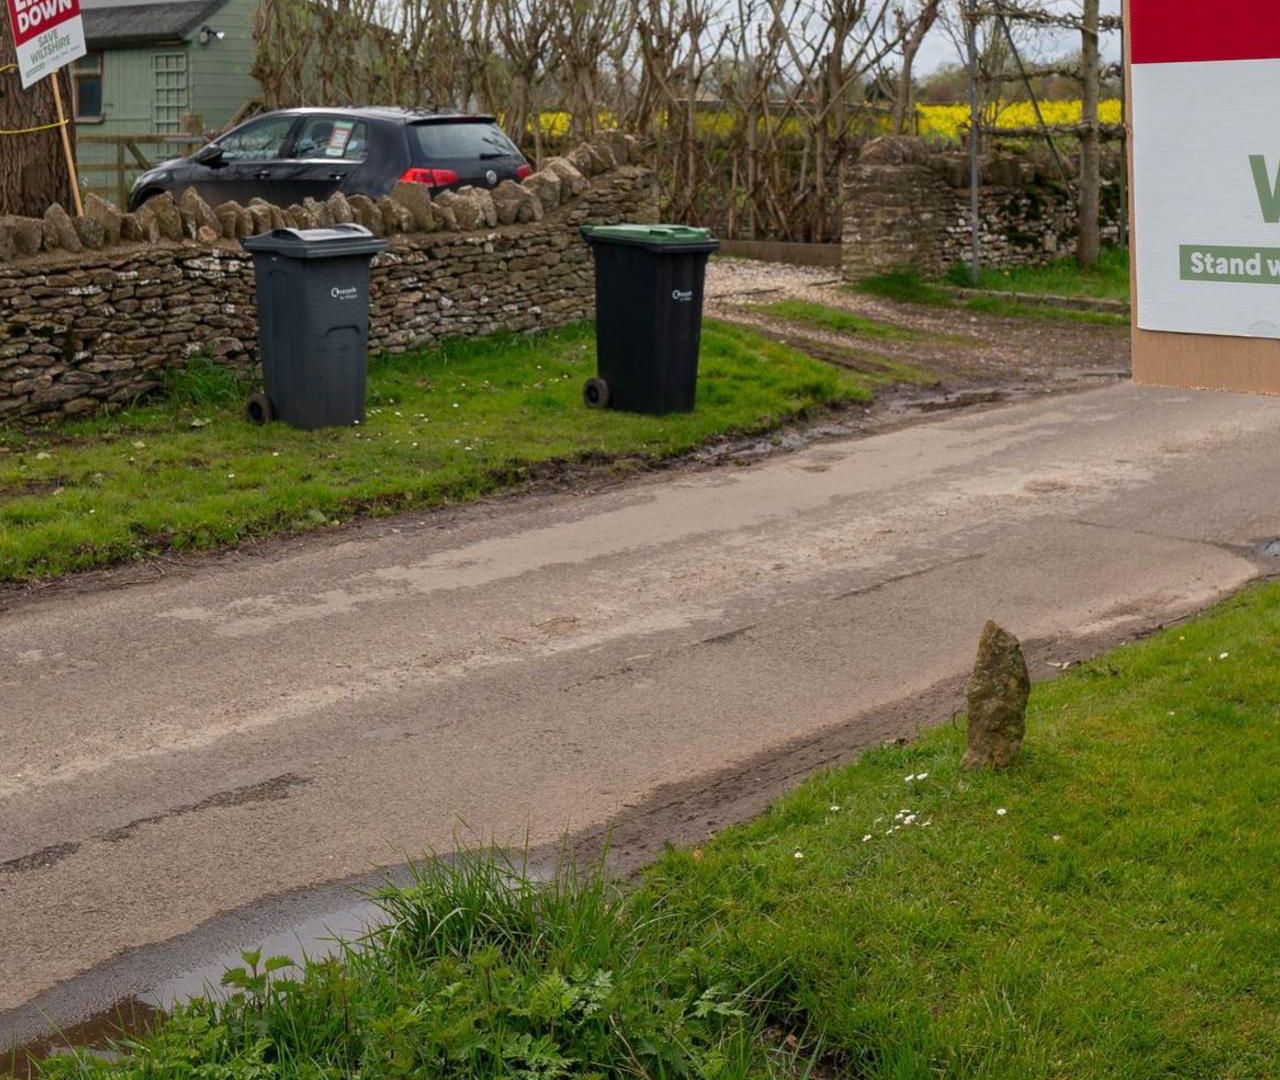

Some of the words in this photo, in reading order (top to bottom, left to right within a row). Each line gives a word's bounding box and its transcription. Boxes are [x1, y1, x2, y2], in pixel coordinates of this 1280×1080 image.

[30, 34, 71, 64] WILTSHIRE
[38, 29, 58, 48] SAVE
[1190, 251, 1261, 276] Stand
